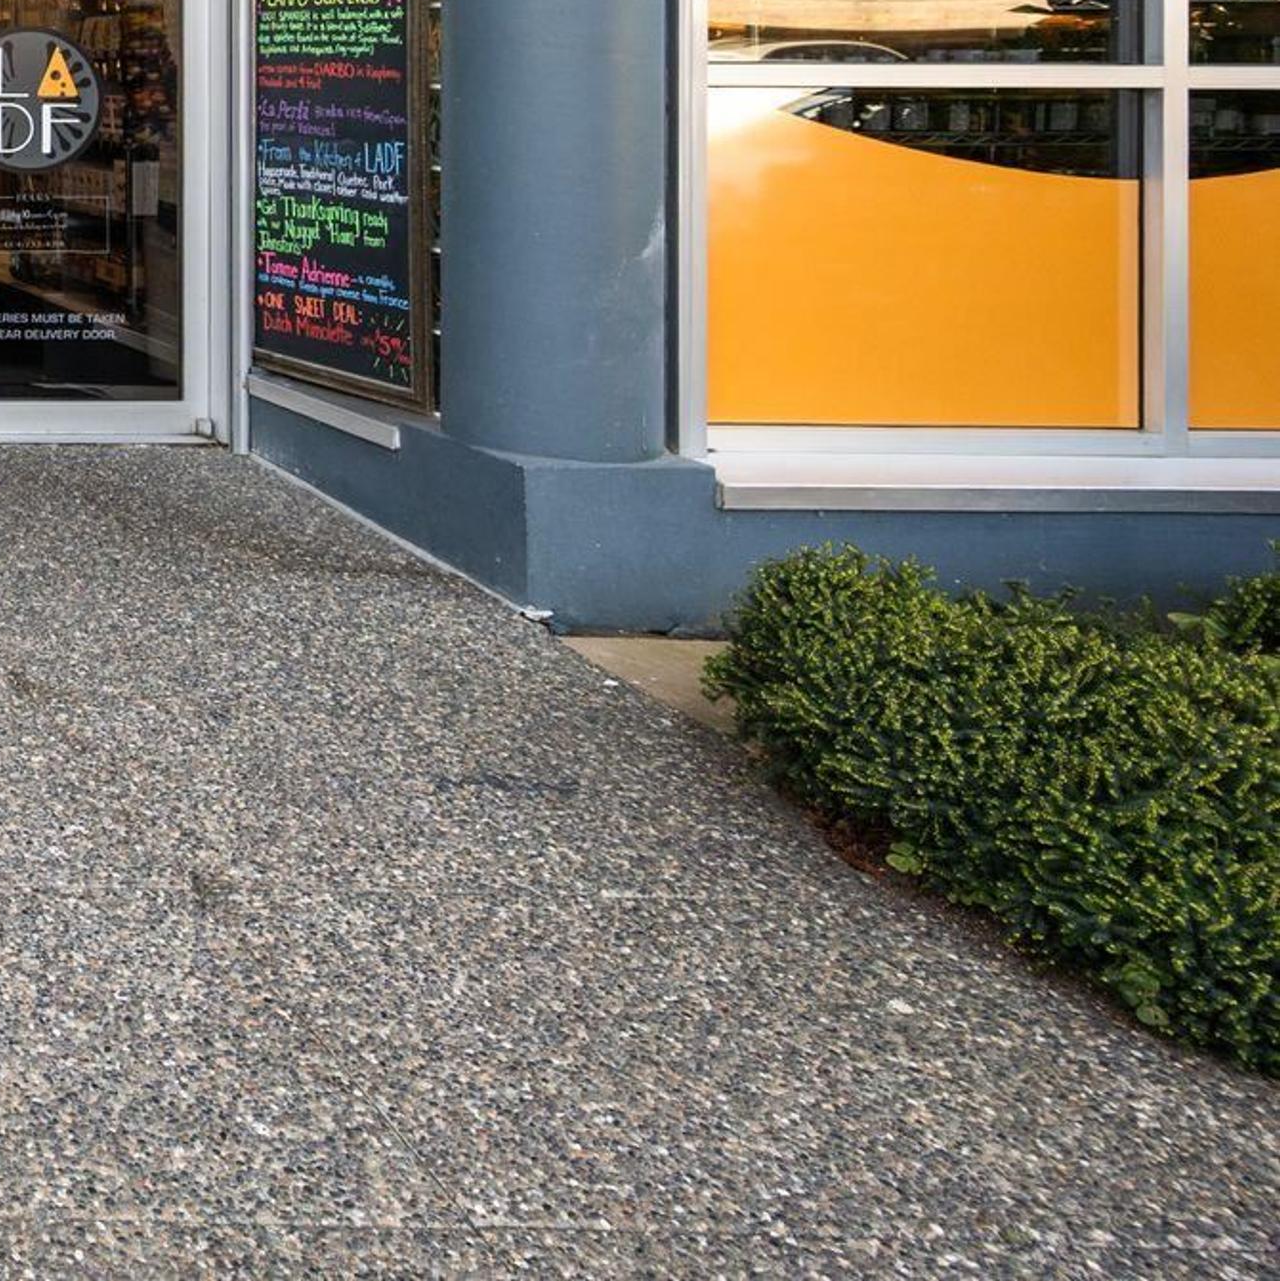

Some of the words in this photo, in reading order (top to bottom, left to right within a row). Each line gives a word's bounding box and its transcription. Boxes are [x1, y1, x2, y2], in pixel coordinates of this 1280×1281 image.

[364, 142, 405, 175] LADF
[264, 291, 284, 310] ONE
[295, 295, 326, 318] SWEET
[31, 312, 64, 324] MUST
[68, 312, 83, 324] BE
[86, 312, 126, 324] TAKEN
[24, 329, 80, 340] DELIVERY
